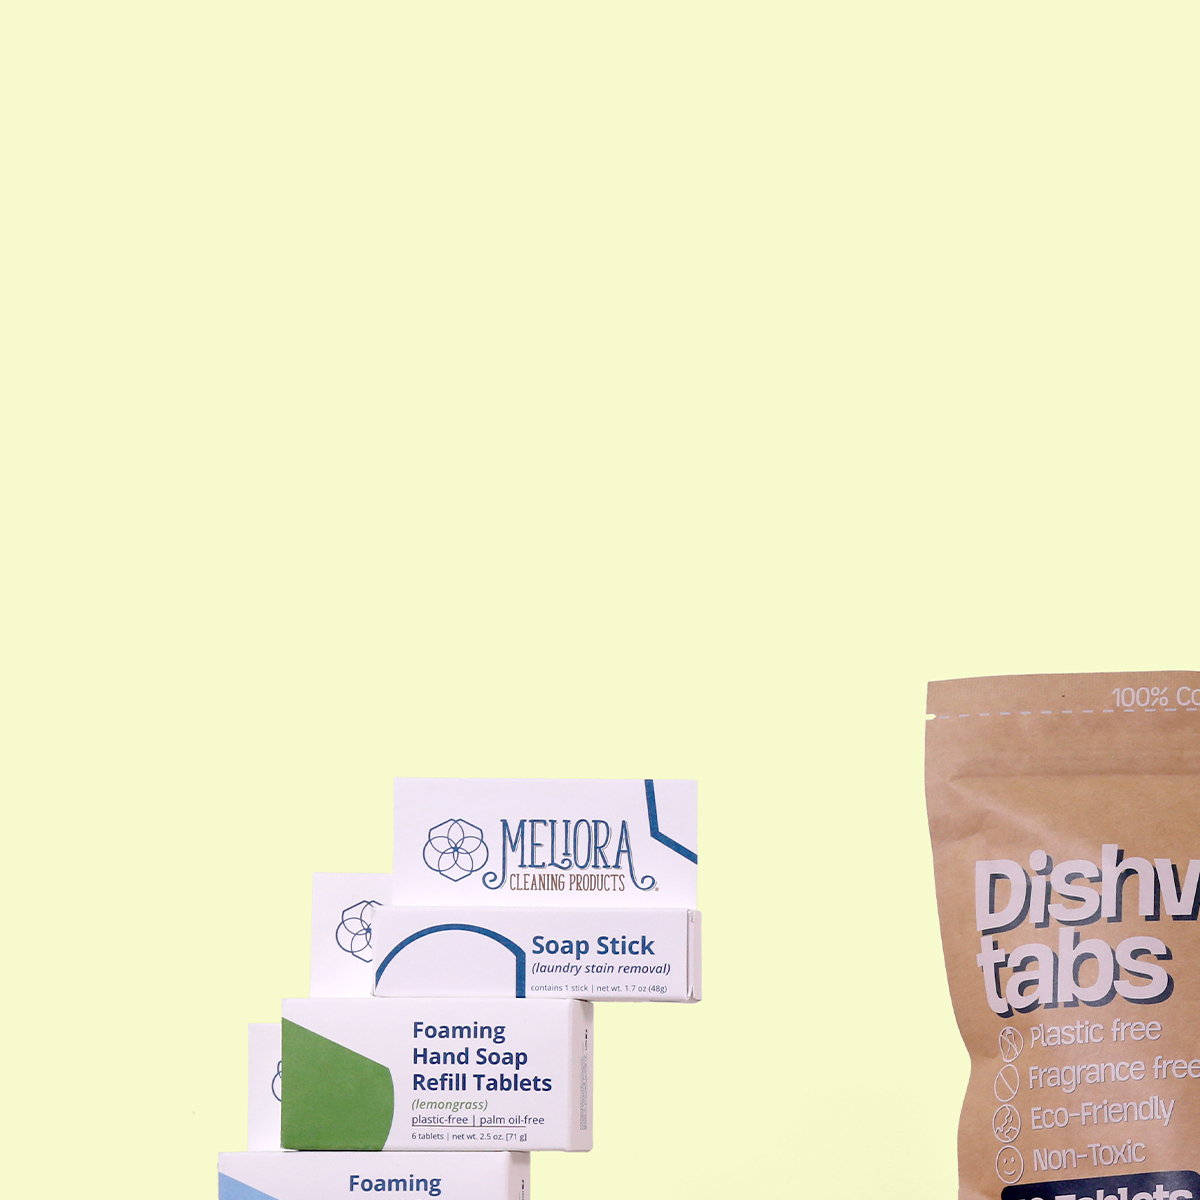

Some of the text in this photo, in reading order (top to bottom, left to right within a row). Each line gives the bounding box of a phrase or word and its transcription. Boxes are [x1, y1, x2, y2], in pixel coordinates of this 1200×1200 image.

[1112, 686, 1169, 707] 100%
[482, 818, 656, 890] MELIORA
[509, 873, 625, 892] CLEANING PRODUCTS
[532, 935, 655, 960] Soap Stick
[532, 962, 671, 977] (laundry stain removal)
[976, 926, 1175, 1018] tabs
[531, 984, 588, 992] contains stick
[412, 1021, 506, 1043] Foaming
[1030, 1018, 1162, 1049] Plastic free
[412, 1047, 528, 1070] Hand Soap
[412, 1073, 552, 1092] Refill Tablets
[1029, 1059, 1146, 1094] Fragrance
[411, 1098, 488, 1112] (lemongrass)
[1031, 1095, 1175, 1130] Eco-Friendly
[411, 1114, 545, 1127] plastic-free palm oil-free
[419, 1132, 444, 1140] tablets
[1033, 1139, 1146, 1172] Non-Toxic
[349, 1174, 442, 1197] Foaming
